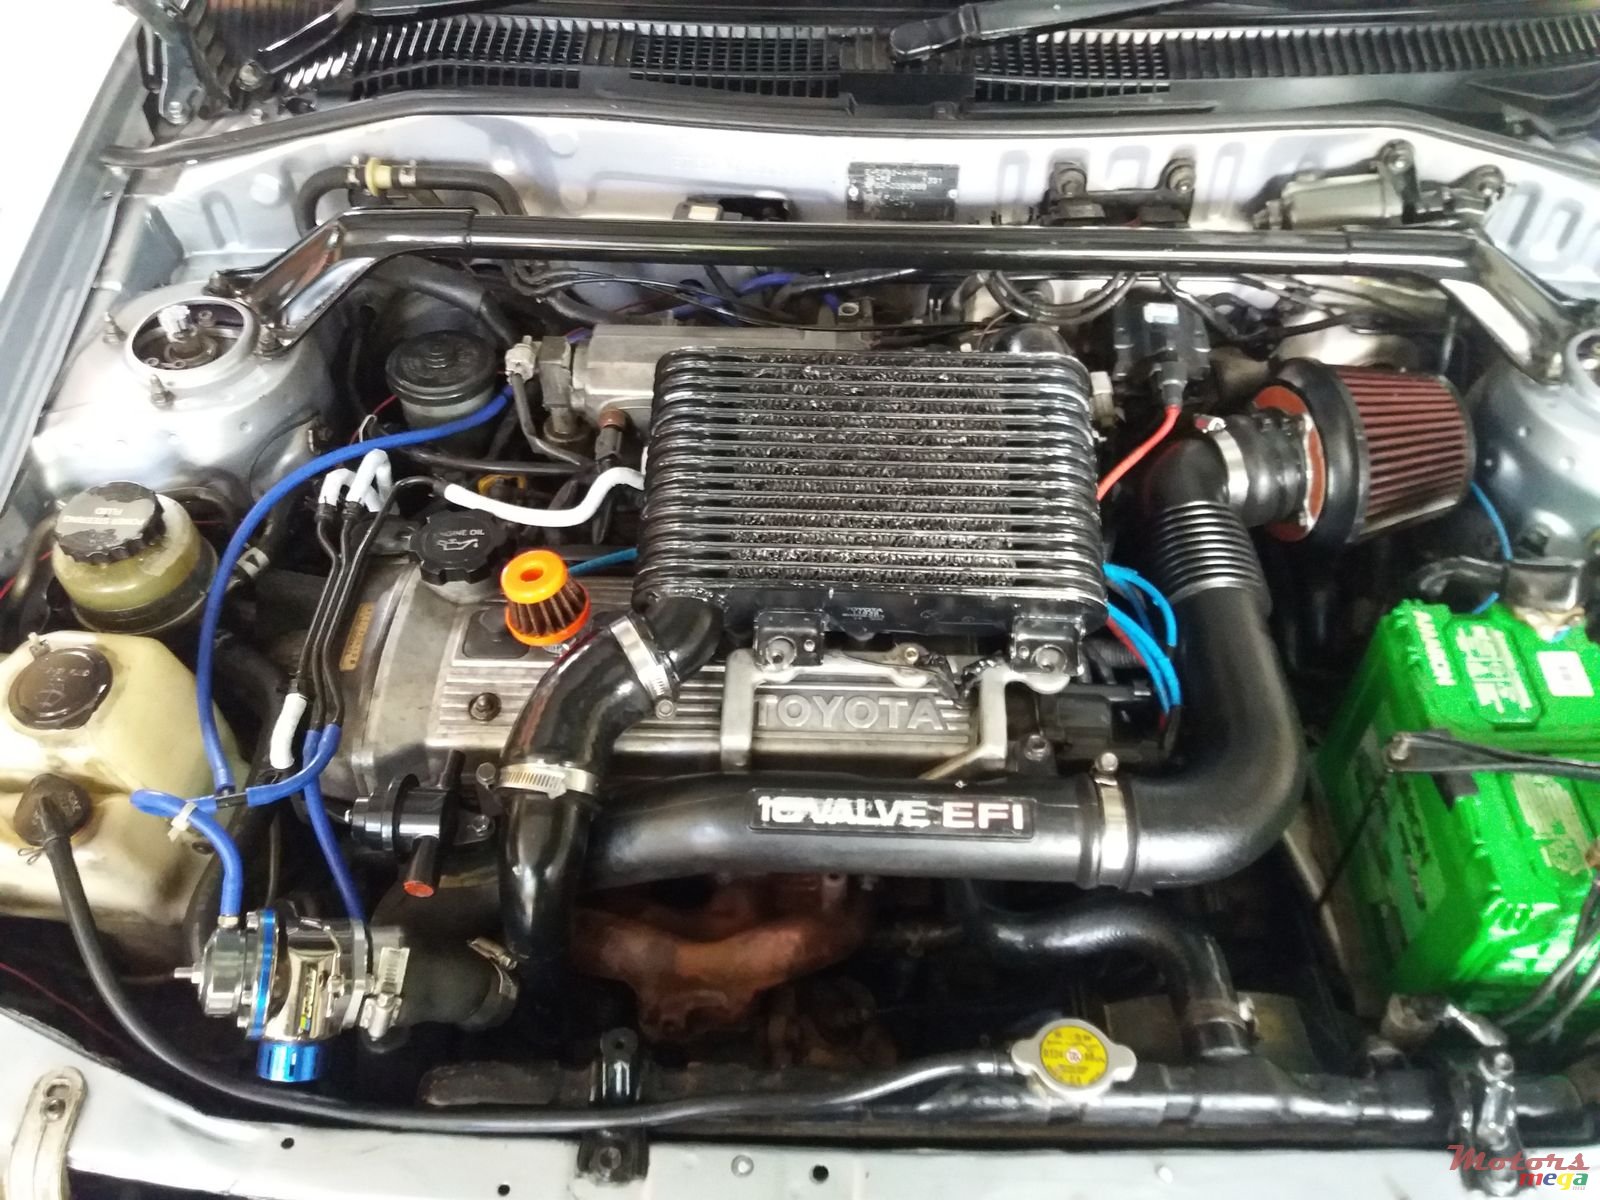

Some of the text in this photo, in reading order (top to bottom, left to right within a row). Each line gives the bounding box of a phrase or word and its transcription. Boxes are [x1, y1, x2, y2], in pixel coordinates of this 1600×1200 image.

[62, 515, 110, 525] STEERING
[94, 507, 123, 515] FLUID
[755, 694, 943, 731] TOYOTA
[942, 801, 1025, 830] EFI
